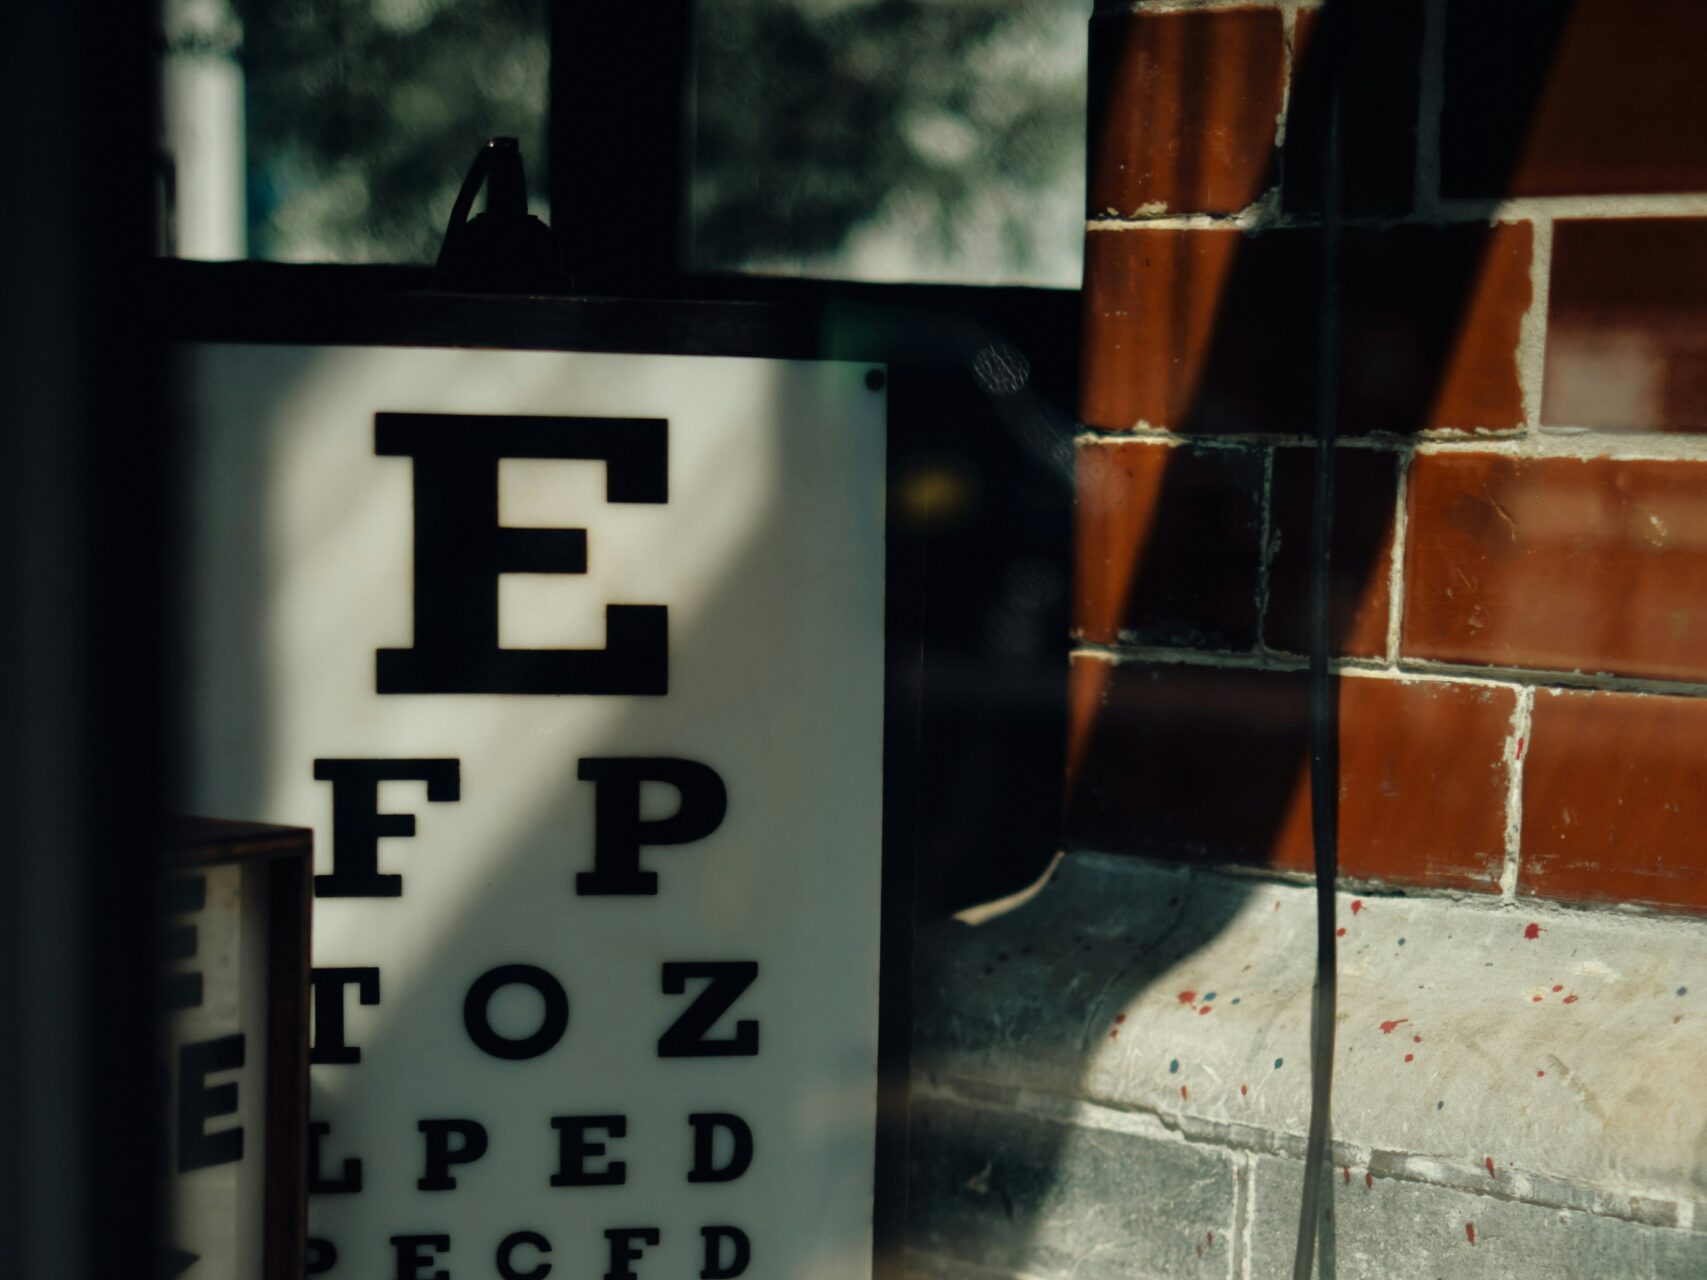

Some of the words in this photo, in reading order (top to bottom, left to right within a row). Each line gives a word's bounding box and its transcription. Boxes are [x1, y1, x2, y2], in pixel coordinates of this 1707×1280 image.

[374, 412, 668, 696] E
[313, 758, 460, 898] F
[576, 757, 727, 895] P
[658, 962, 760, 1058] Z
